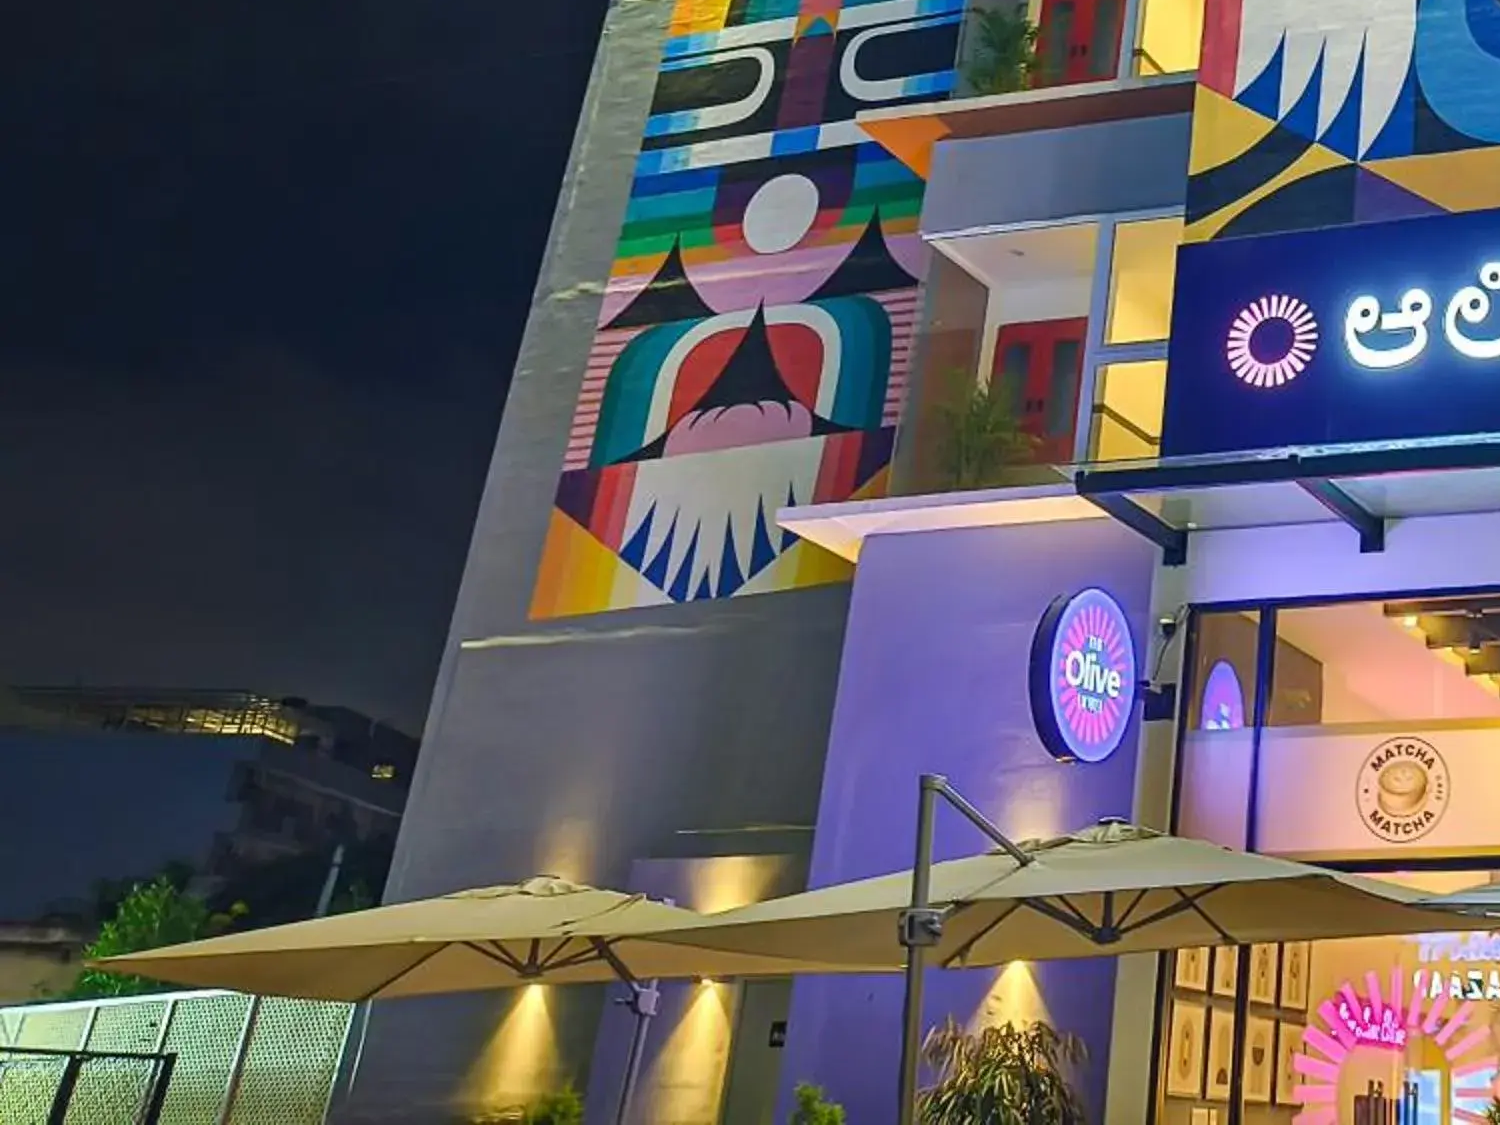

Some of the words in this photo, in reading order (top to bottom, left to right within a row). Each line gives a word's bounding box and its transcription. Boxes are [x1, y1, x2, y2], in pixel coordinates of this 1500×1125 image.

[1065, 650, 1121, 698] Olive
[1370, 744, 1435, 771] MATCHA
[1369, 810, 1435, 835] MATCHA
